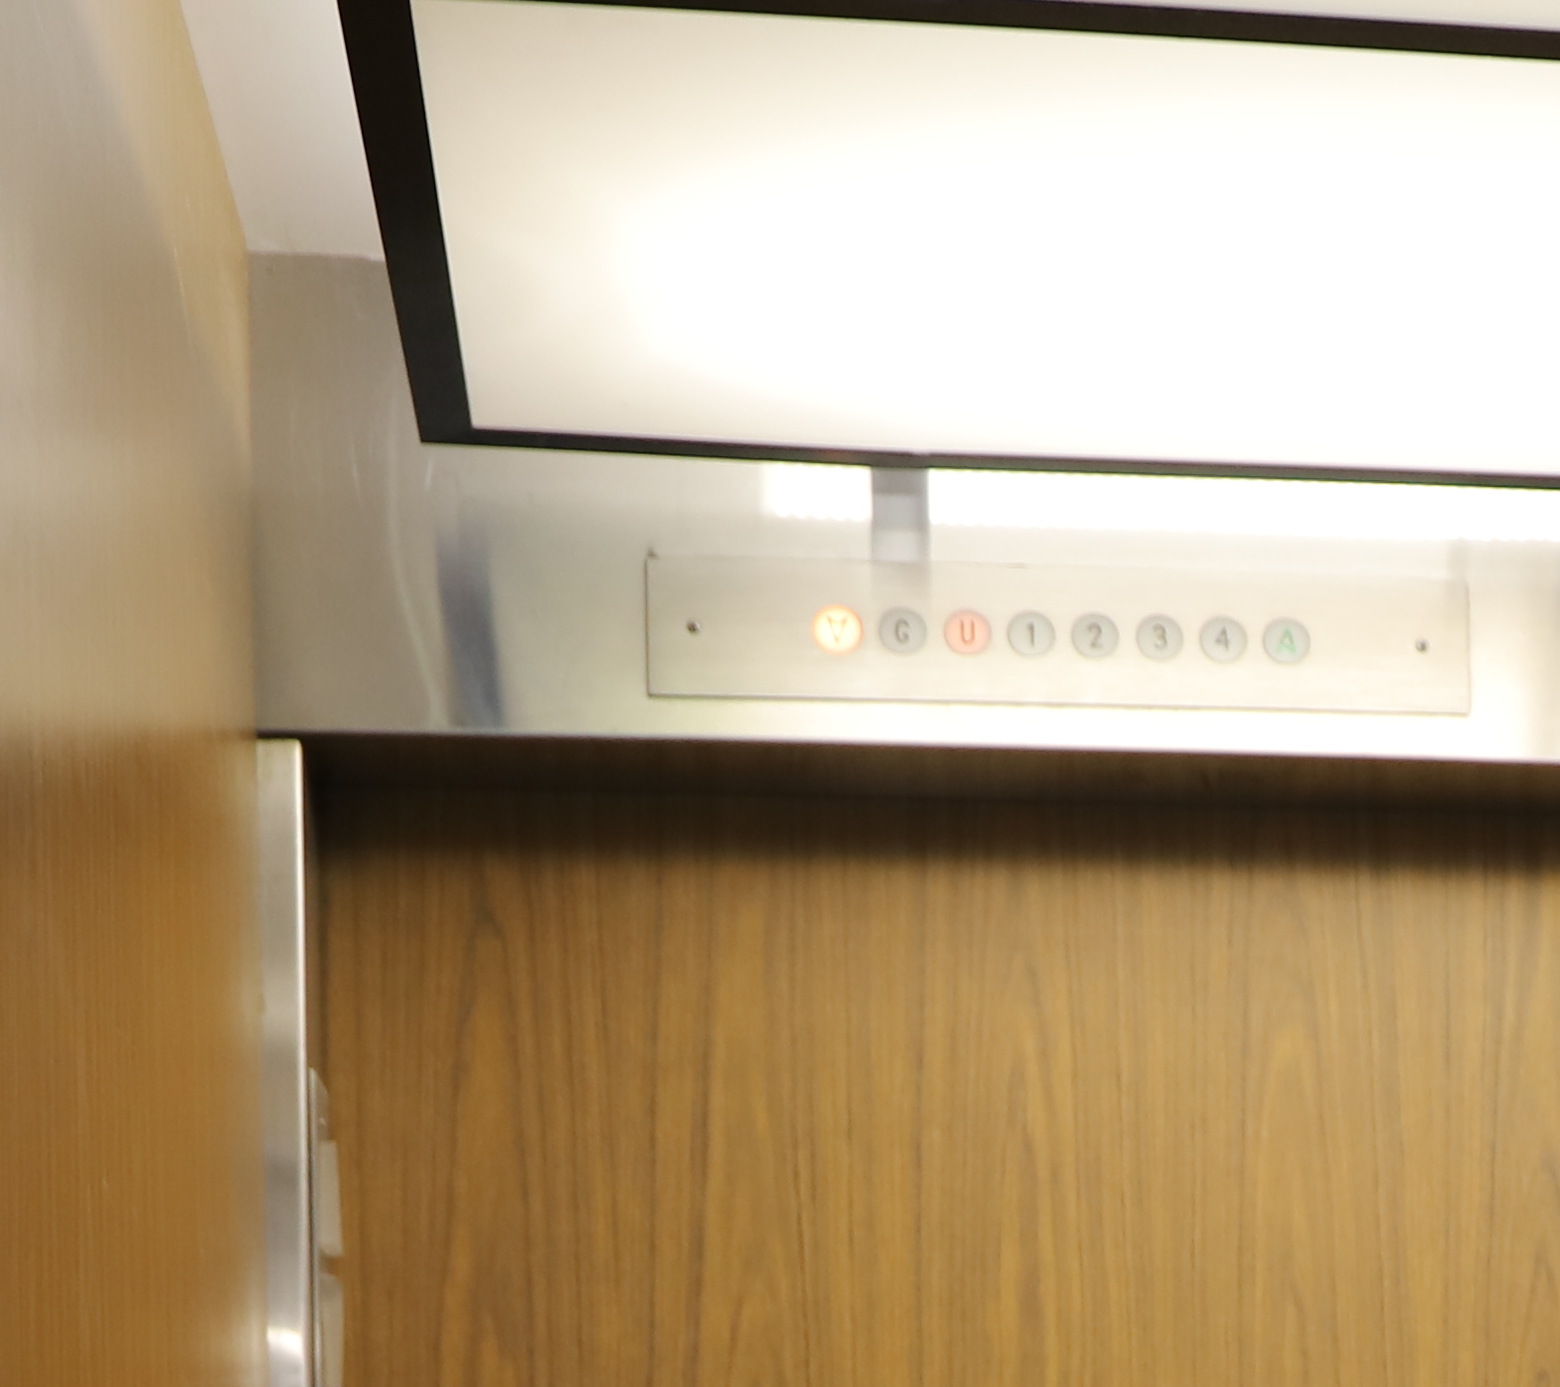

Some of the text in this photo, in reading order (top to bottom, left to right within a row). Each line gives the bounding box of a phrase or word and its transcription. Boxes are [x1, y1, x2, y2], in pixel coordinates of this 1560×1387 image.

[894, 617, 910, 644] G
[959, 619, 975, 646] U
[1087, 622, 1103, 649] 2
[1152, 623, 1168, 650] 3
[1213, 626, 1230, 652] 4
